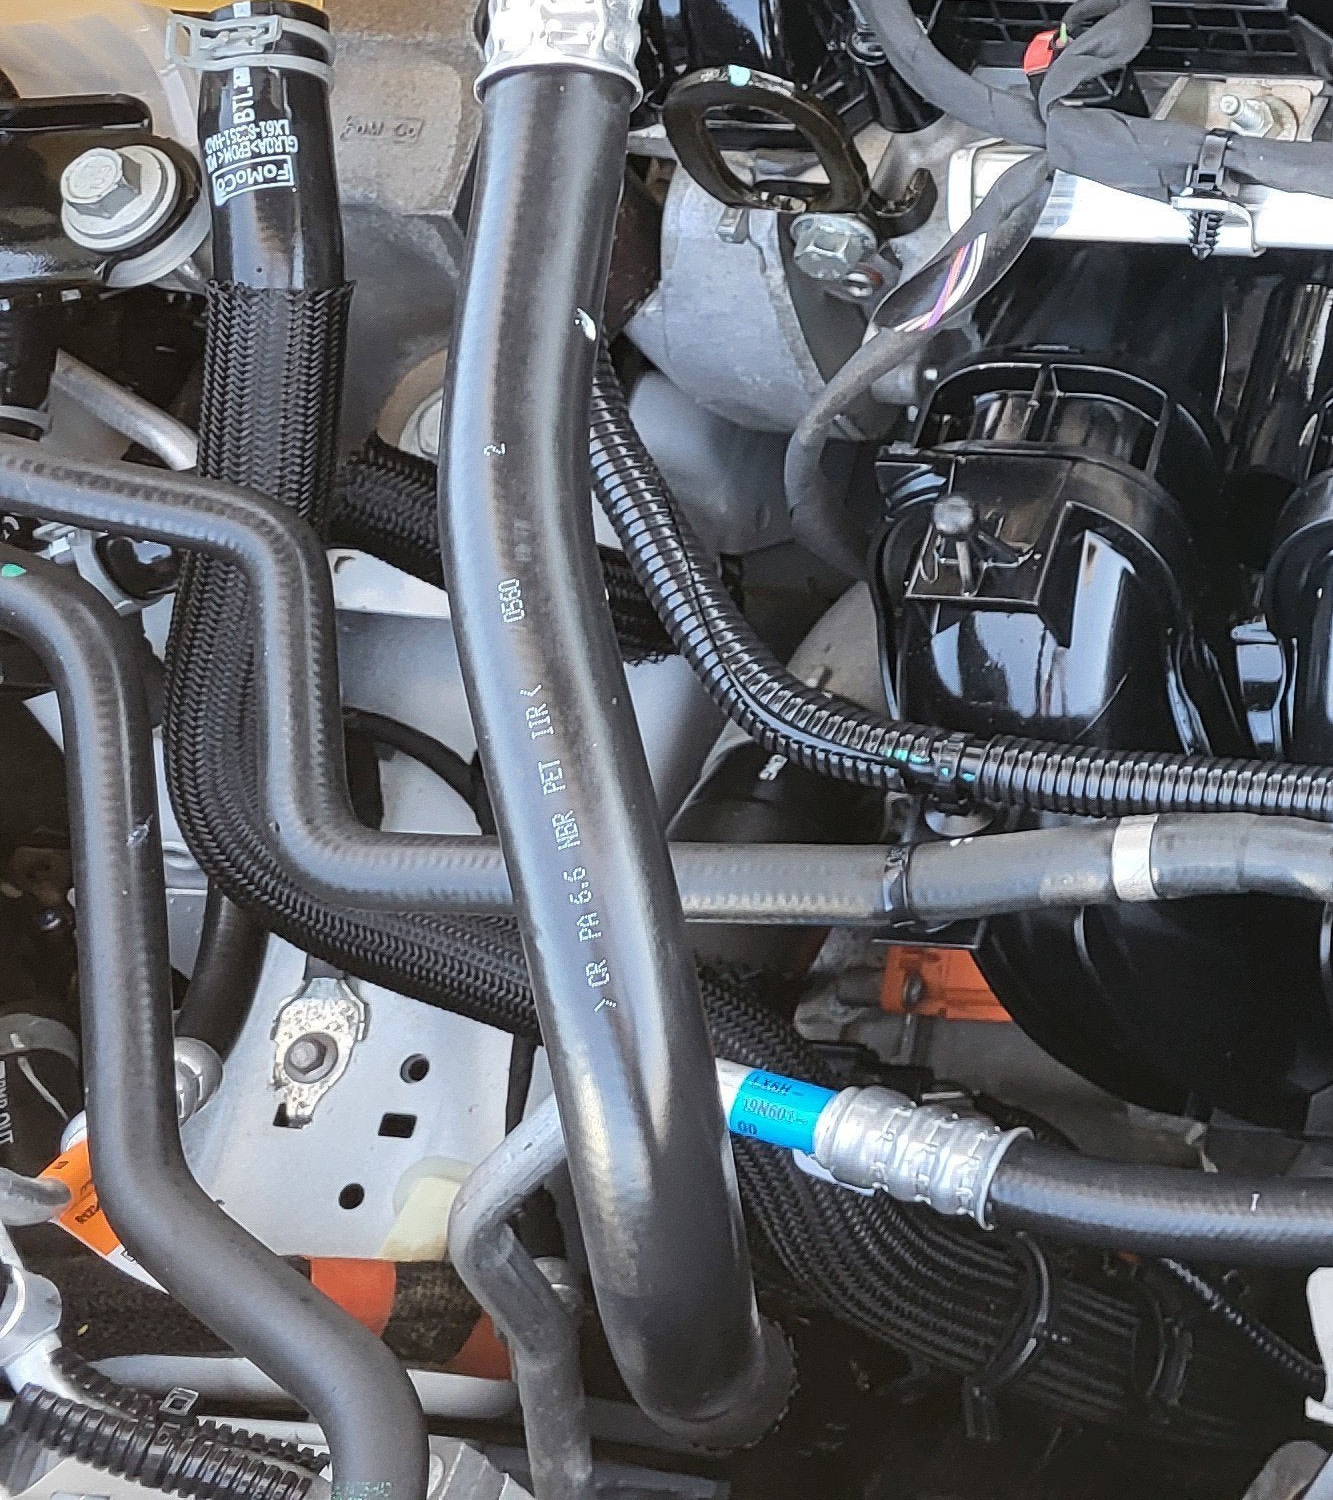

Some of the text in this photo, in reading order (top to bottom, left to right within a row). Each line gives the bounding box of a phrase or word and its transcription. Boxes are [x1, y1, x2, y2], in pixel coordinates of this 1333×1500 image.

[216, 163, 289, 194] FoMoCo
[537, 758, 566, 796] PET
[551, 810, 581, 851] NBR
